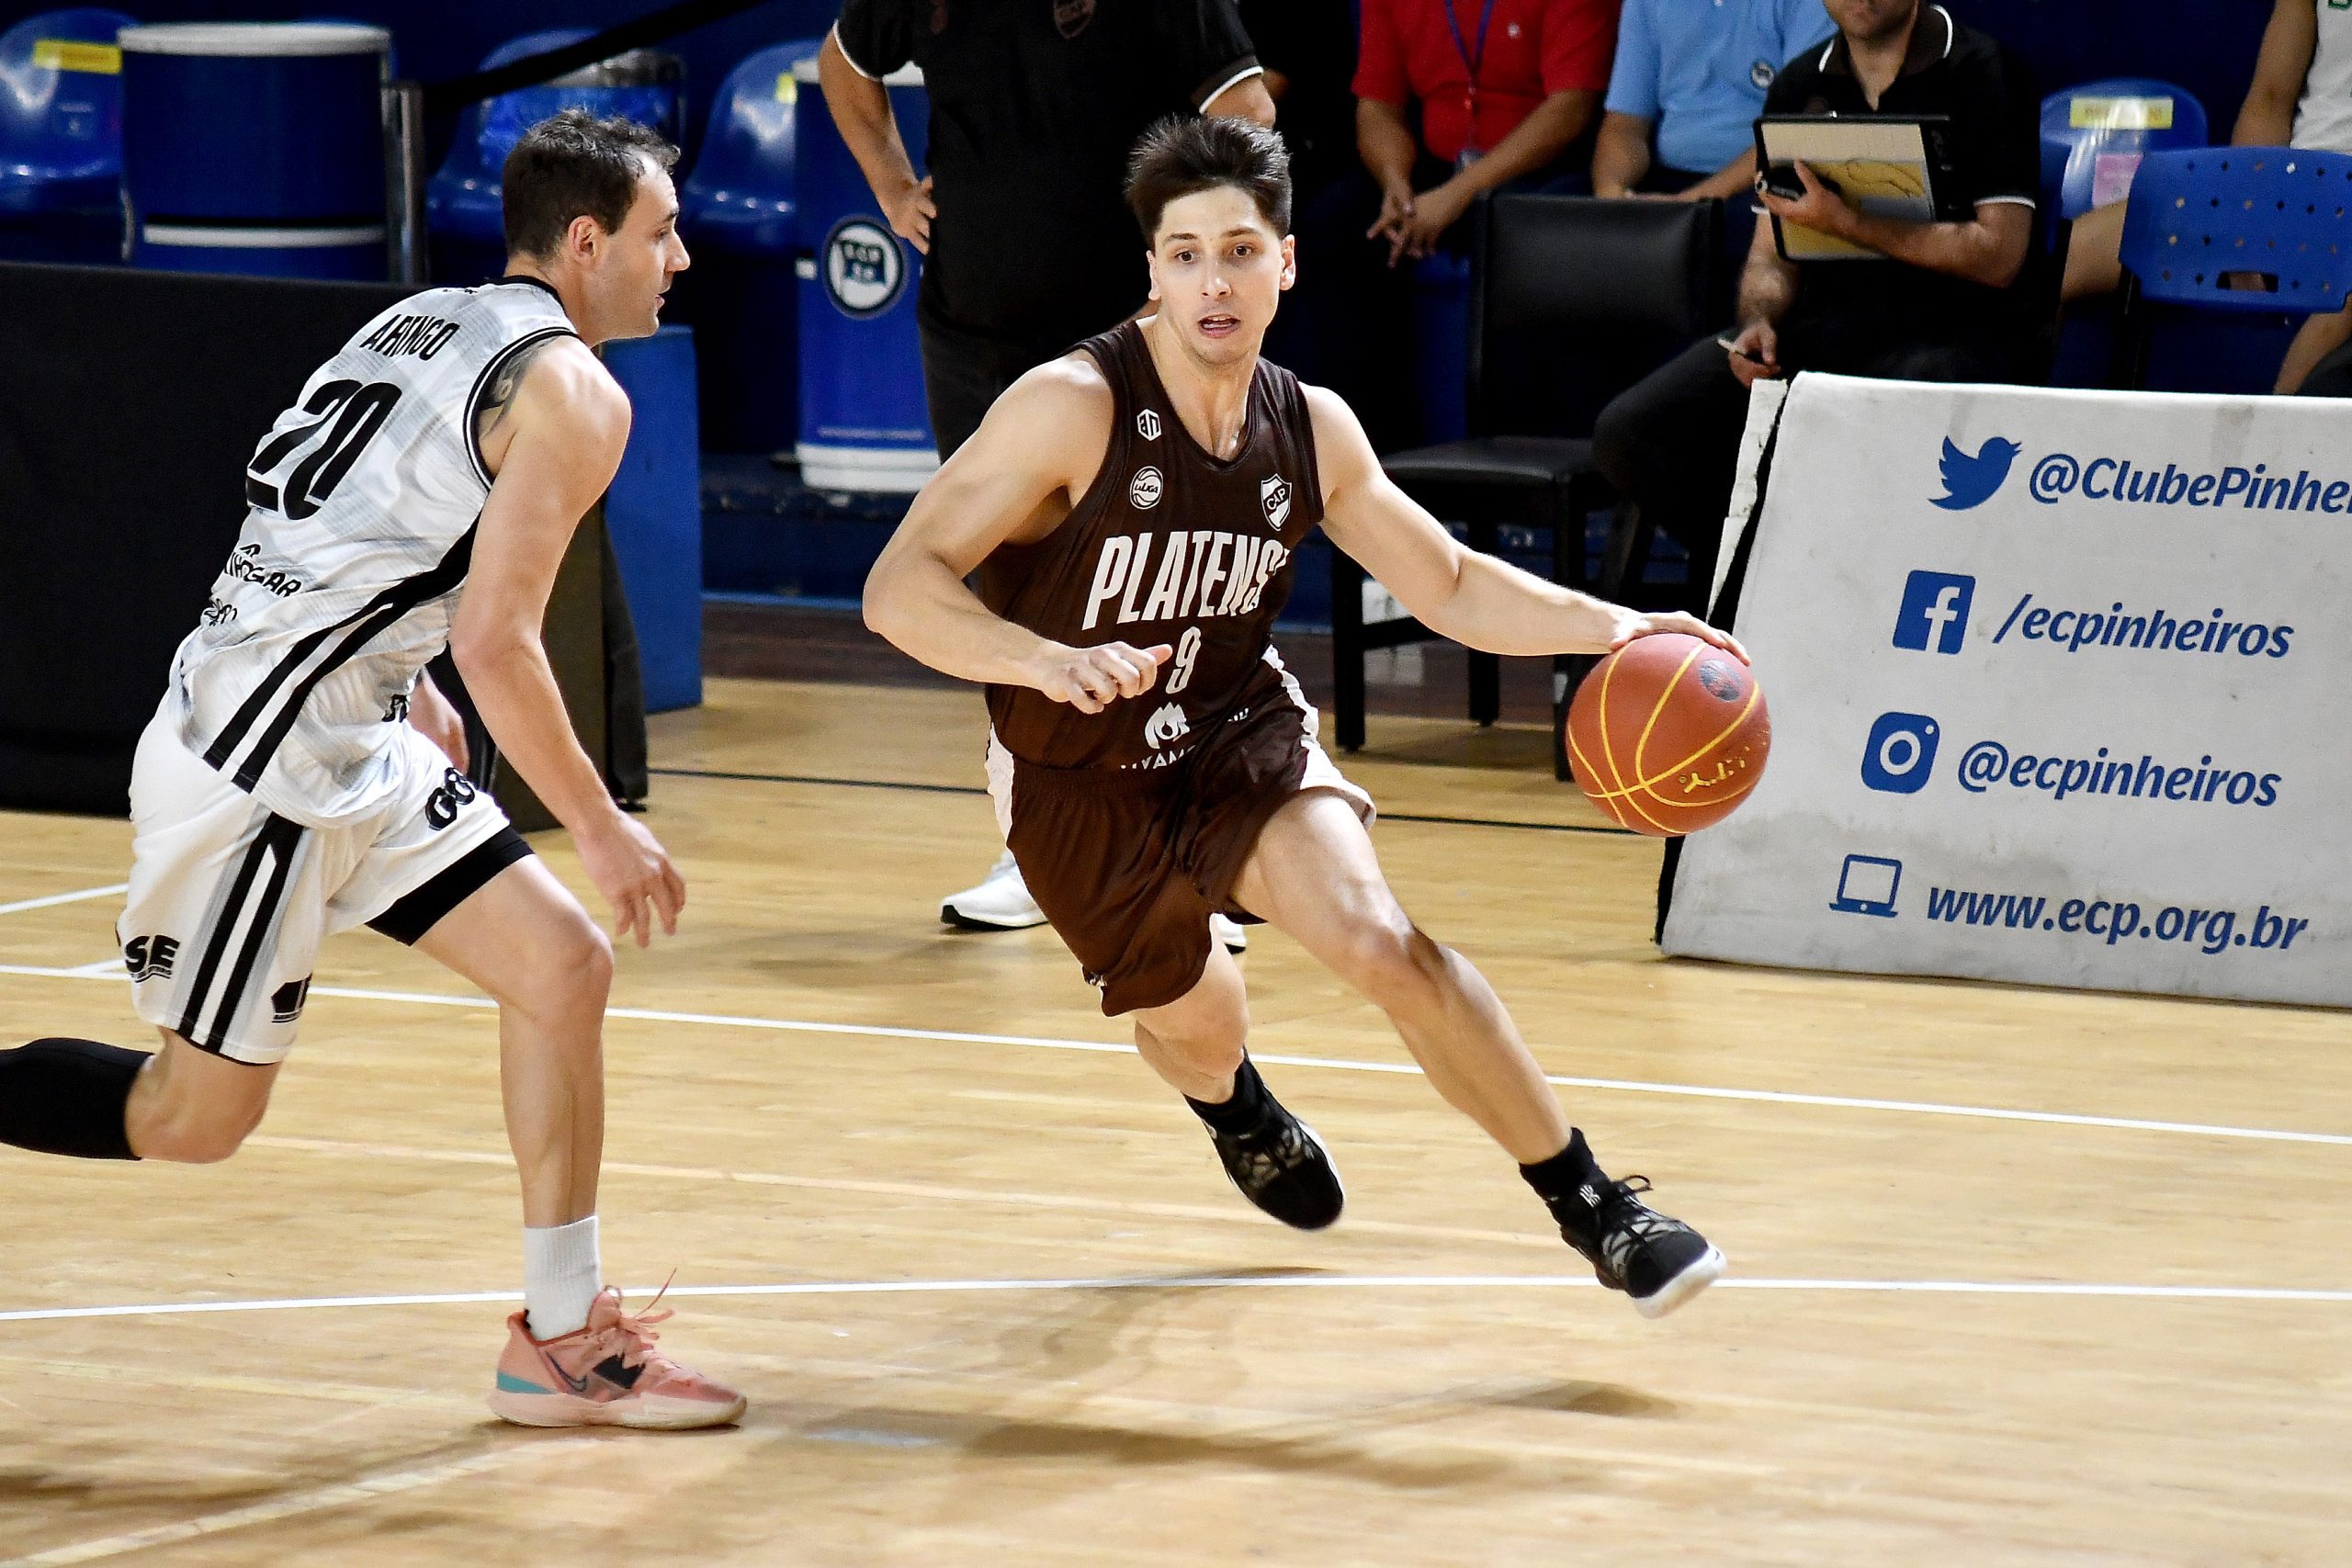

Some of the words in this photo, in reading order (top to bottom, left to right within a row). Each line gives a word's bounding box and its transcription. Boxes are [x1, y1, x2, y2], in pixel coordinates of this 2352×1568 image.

[245, 378, 402, 521] 20
[1266, 488, 1286, 511] CAP
[1081, 530, 1290, 630] PLATENS
[1165, 626, 1201, 694] 9
[1992, 593, 2295, 659] /ecpinheiros
[1957, 740, 2283, 807] @ecpinheiros
[1927, 886, 2309, 955] www.ecp.org.br
